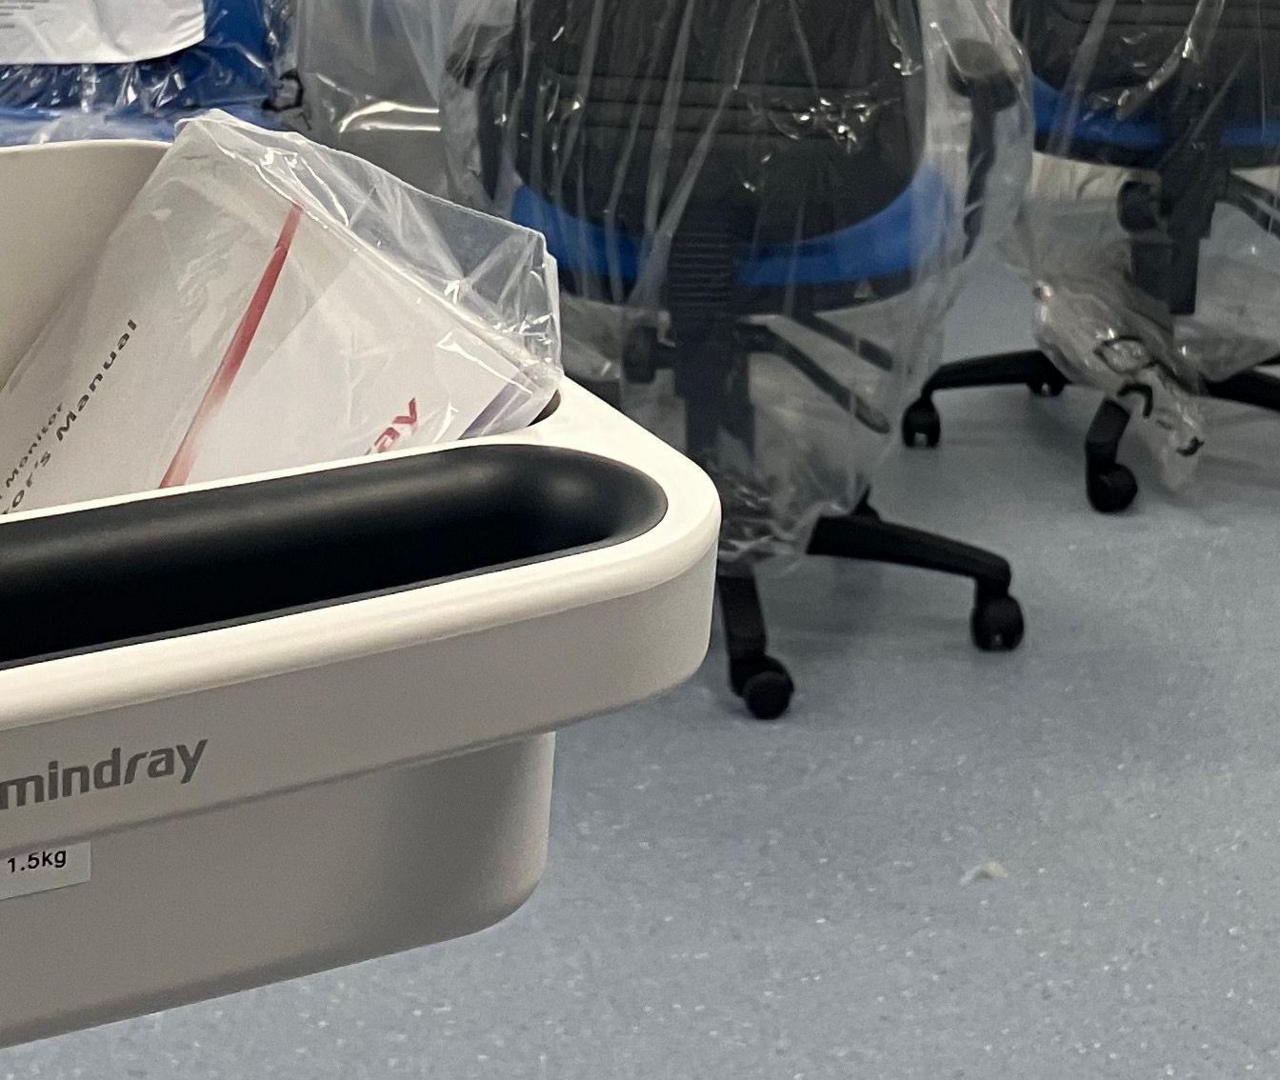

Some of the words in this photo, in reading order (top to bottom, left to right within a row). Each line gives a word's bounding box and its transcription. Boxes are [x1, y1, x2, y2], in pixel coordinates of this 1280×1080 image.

[56, 319, 137, 441] Manual
[6, 402, 63, 488] Monitor
[7, 849, 67, 873] 1.5kg
